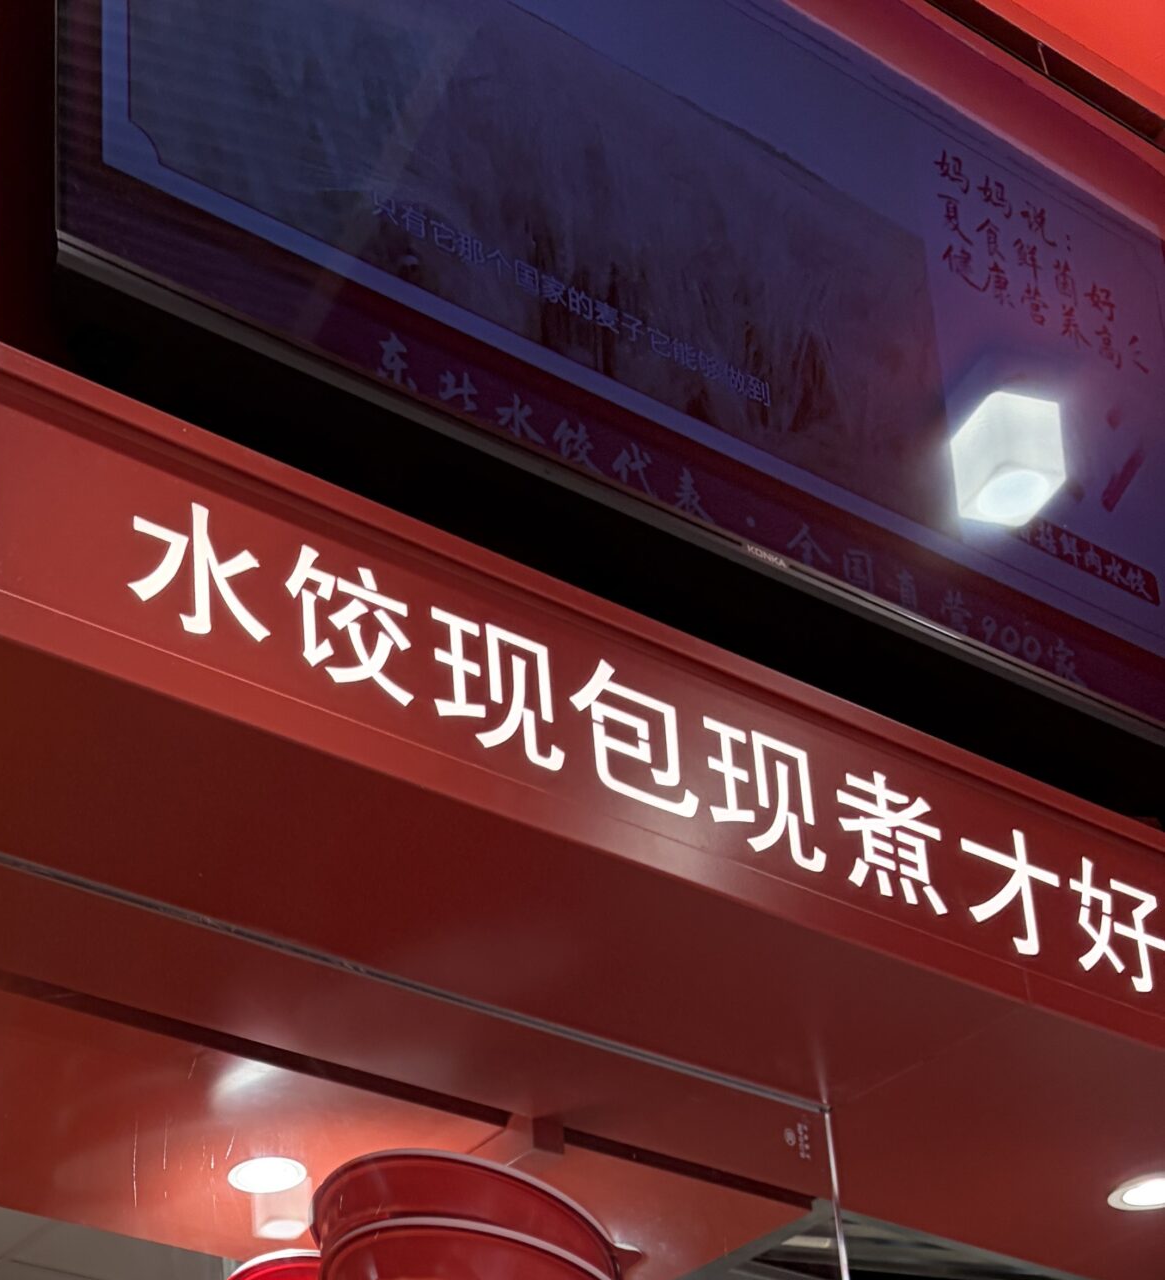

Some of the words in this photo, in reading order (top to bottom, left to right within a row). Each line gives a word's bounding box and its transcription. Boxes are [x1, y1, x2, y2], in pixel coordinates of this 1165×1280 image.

[746, 543, 788, 569] KONKA
[127, 501, 1165, 993] 水饺现包现煮才好
